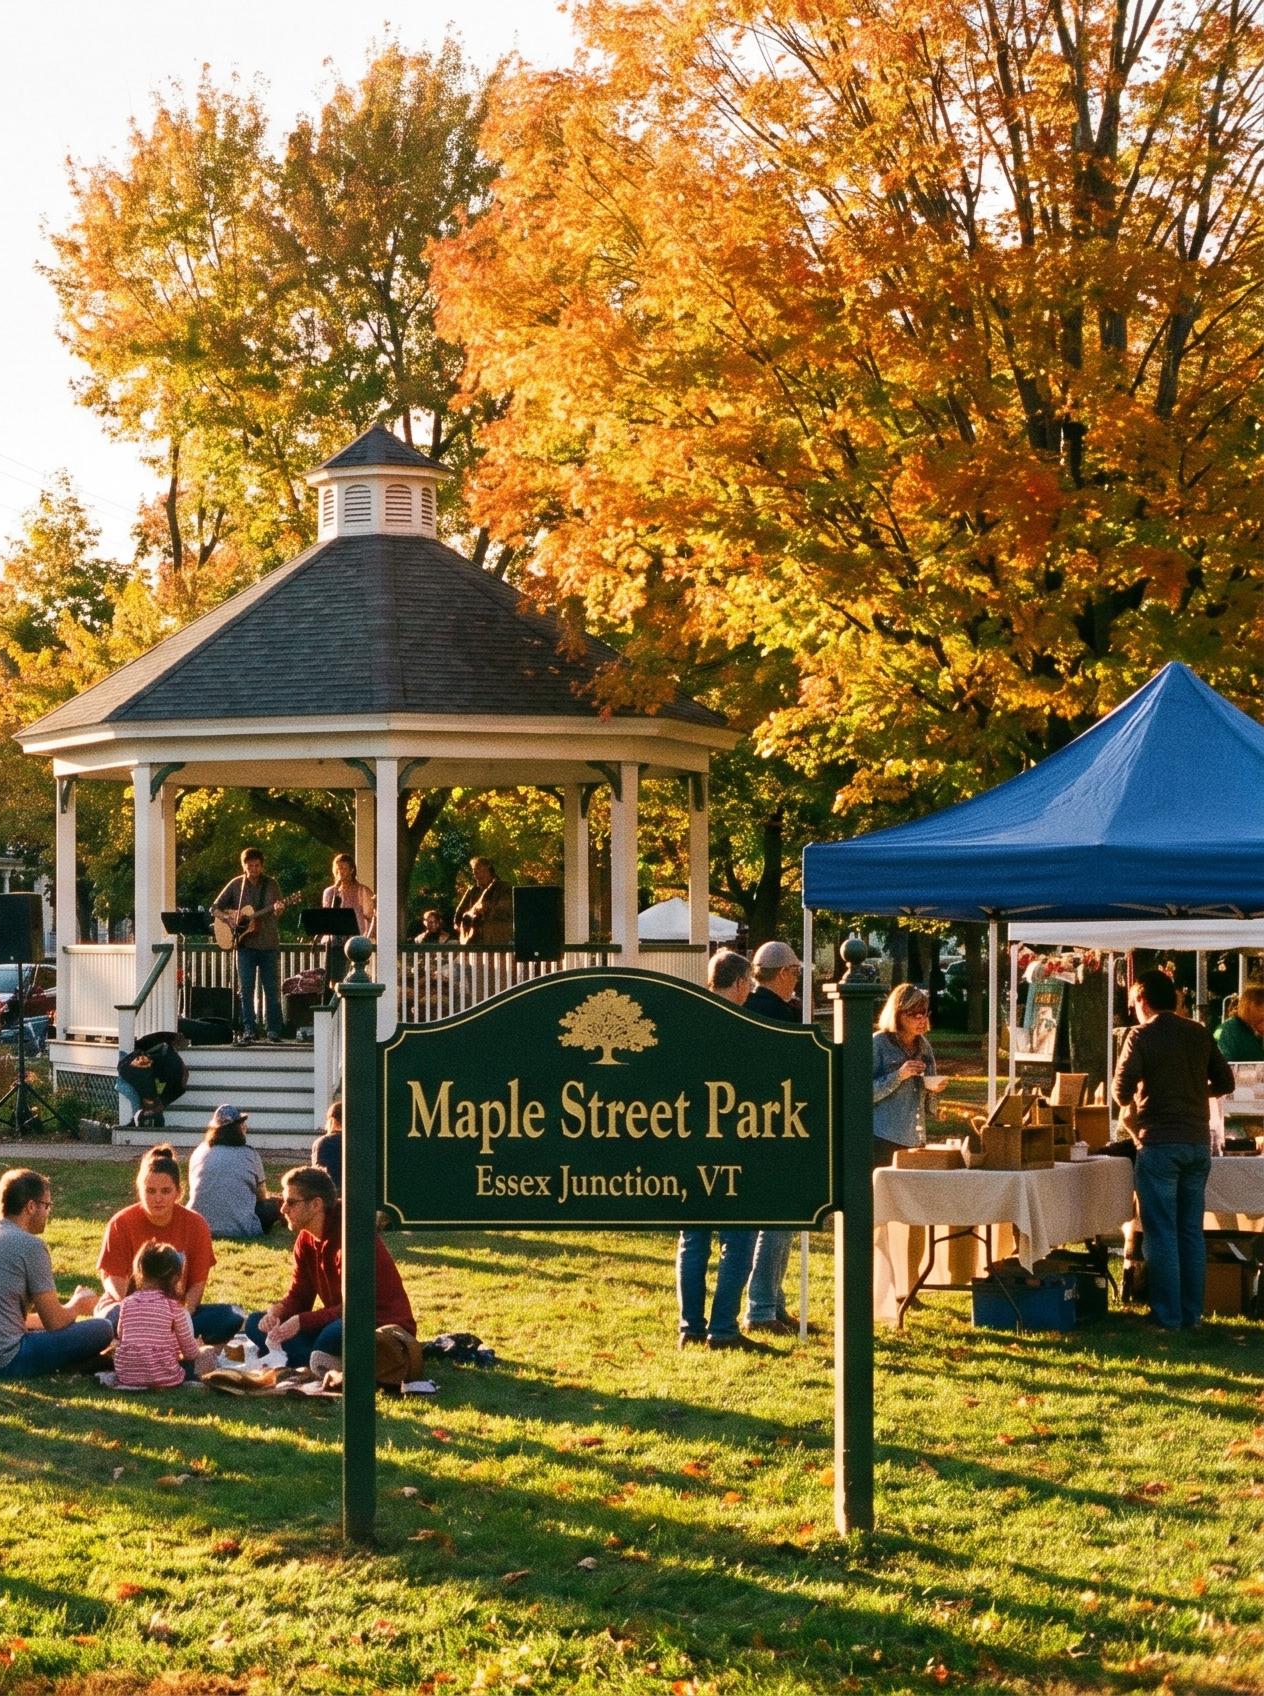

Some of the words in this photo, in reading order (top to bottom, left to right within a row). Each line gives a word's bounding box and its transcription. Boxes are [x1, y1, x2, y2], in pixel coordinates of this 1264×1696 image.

[407, 1078, 545, 1154] Maple
[561, 1080, 691, 1138] Street
[704, 1079, 809, 1138] Park
[476, 1165, 551, 1196] Essex
[558, 1165, 687, 1203] Junction,
[697, 1165, 742, 1196] VT
